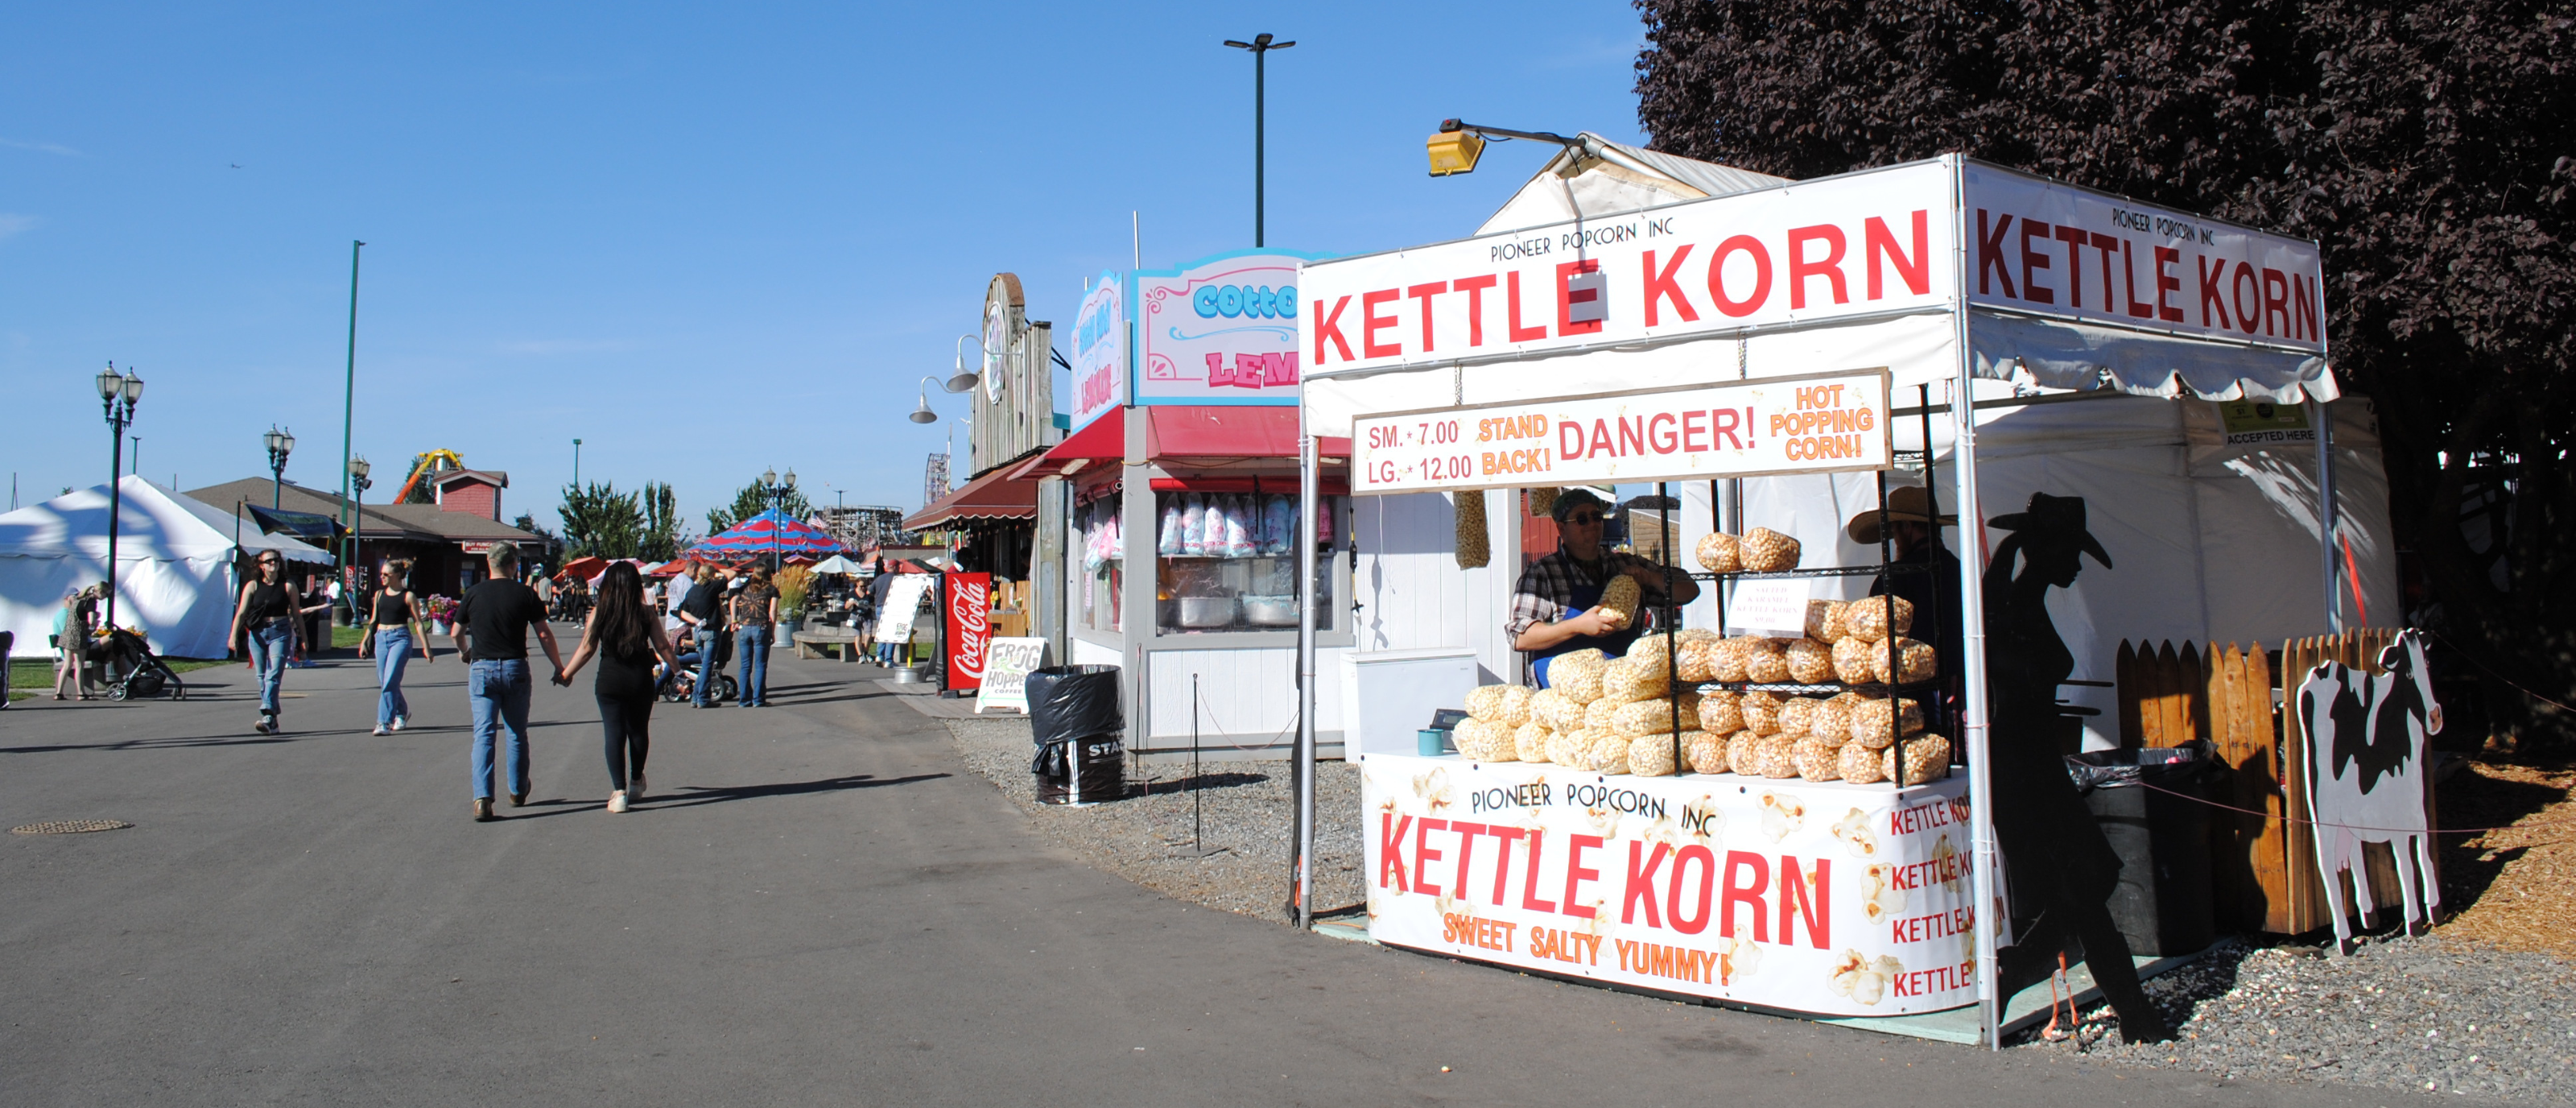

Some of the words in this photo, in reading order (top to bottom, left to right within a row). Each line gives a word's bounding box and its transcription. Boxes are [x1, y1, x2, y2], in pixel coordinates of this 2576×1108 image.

[1492, 237, 1550, 263] PIONEER
[1563, 223, 1636, 250] POPCORN
[1649, 217, 1674, 238] INC
[2113, 208, 2150, 233] PIONEER
[2157, 217, 2194, 241] POPCORN
[2200, 229, 2214, 246] INC
[1314, 258, 1603, 365] KETTLE
[1642, 209, 1930, 327] KORN
[1977, 208, 2184, 323] KETTLE
[2198, 254, 2318, 342] KORN
[1205, 352, 1298, 389] LEM
[1796, 384, 1844, 410] HOT
[1368, 425, 1403, 449] SM.
[1418, 420, 1458, 445] 7.00
[1479, 415, 1547, 441] STAND
[1558, 406, 1755, 461] DANGER!
[1771, 407, 1873, 436] POPPING
[2227, 431, 2284, 444] ACCEPTED
[2287, 430, 2315, 440] HERE
[1482, 448, 1551, 475] BACK!
[1785, 435, 1861, 461] CORN!
[1368, 461, 1402, 483] LG.
[1420, 456, 1472, 481] 12.00
[953, 577, 987, 678] Coca-Cola
[991, 643, 1041, 671] FROG
[1472, 783, 1552, 813] PIONEER
[1567, 784, 1666, 821] POPCORN
[1681, 804, 1716, 837] INC
[1891, 801, 1948, 835] KETTLE
[1380, 812, 1604, 920] KETTLE
[1621, 840, 1831, 950] KORN
[1893, 855, 1957, 891] KETTLE
[1893, 908, 1964, 944] KETTLE
[1443, 912, 1517, 953] SWEET
[1530, 926, 1602, 966] SALTY
[1615, 938, 1728, 986] YUMMY!
[1893, 962, 1971, 998] KETTLE
